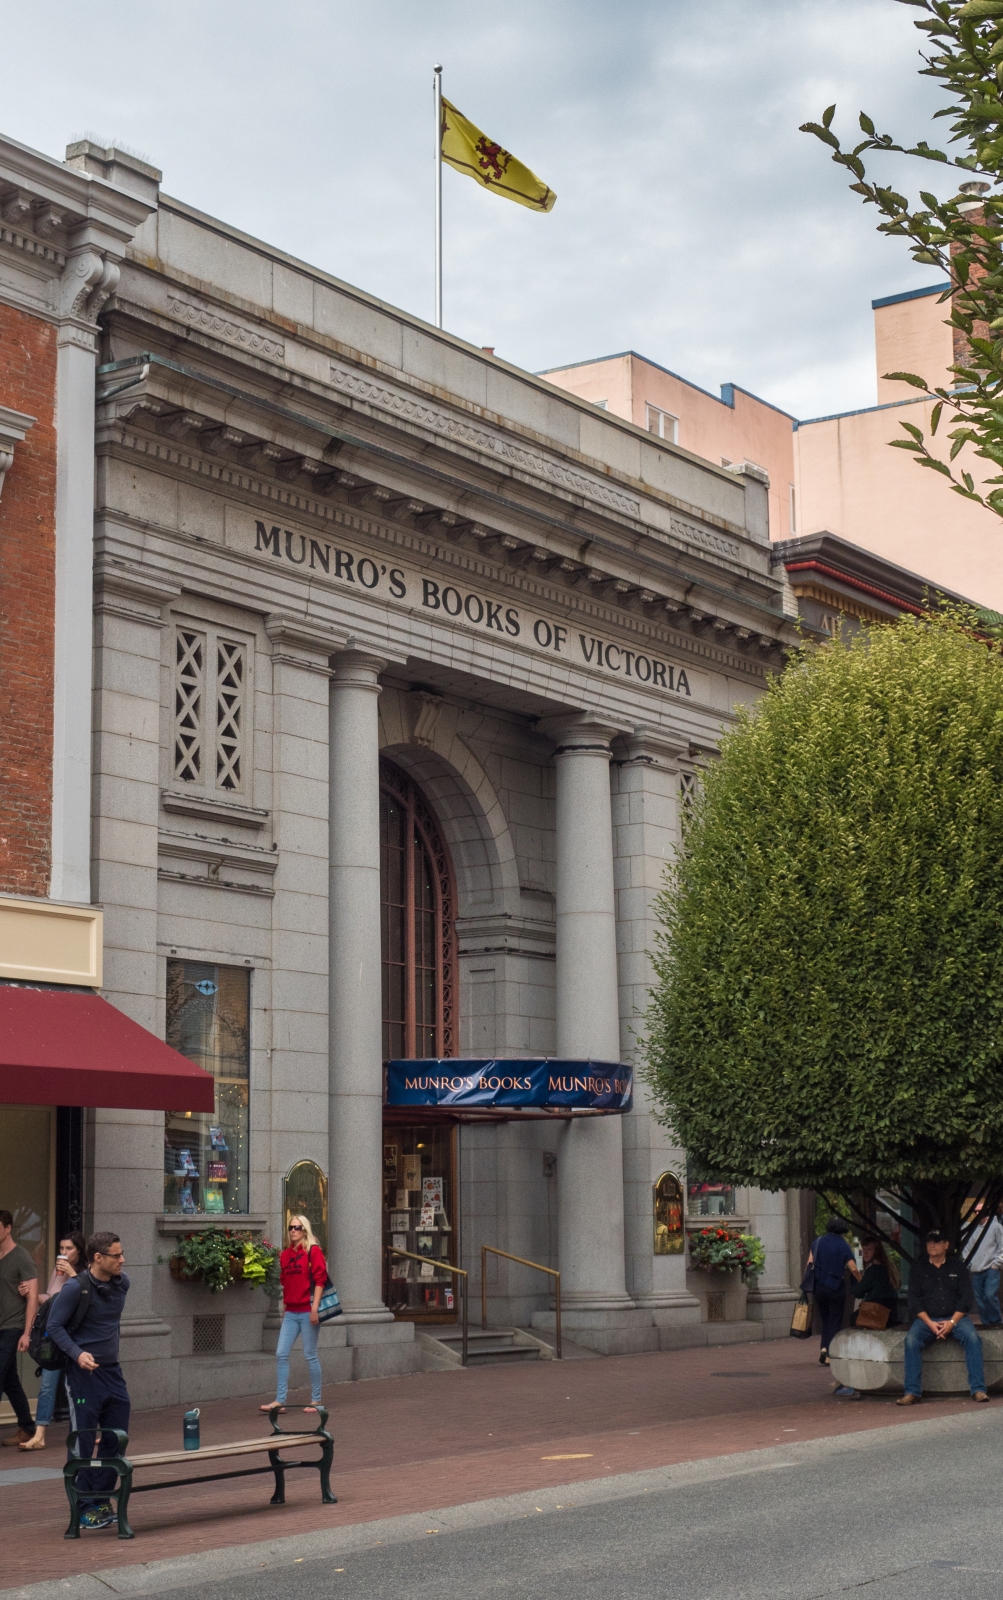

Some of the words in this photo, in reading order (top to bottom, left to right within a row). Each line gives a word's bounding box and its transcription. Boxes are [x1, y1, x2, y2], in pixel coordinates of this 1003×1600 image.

[254, 519, 407, 599] MUNRO'S
[421, 578, 521, 637] BOOKS
[533, 619, 568, 651] OF
[578, 634, 692, 697] VICTORIA
[404, 1076, 474, 1093] MUNRO'S
[478, 1075, 532, 1091] BOOKS
[547, 1075, 612, 1096] MUNRO'S
